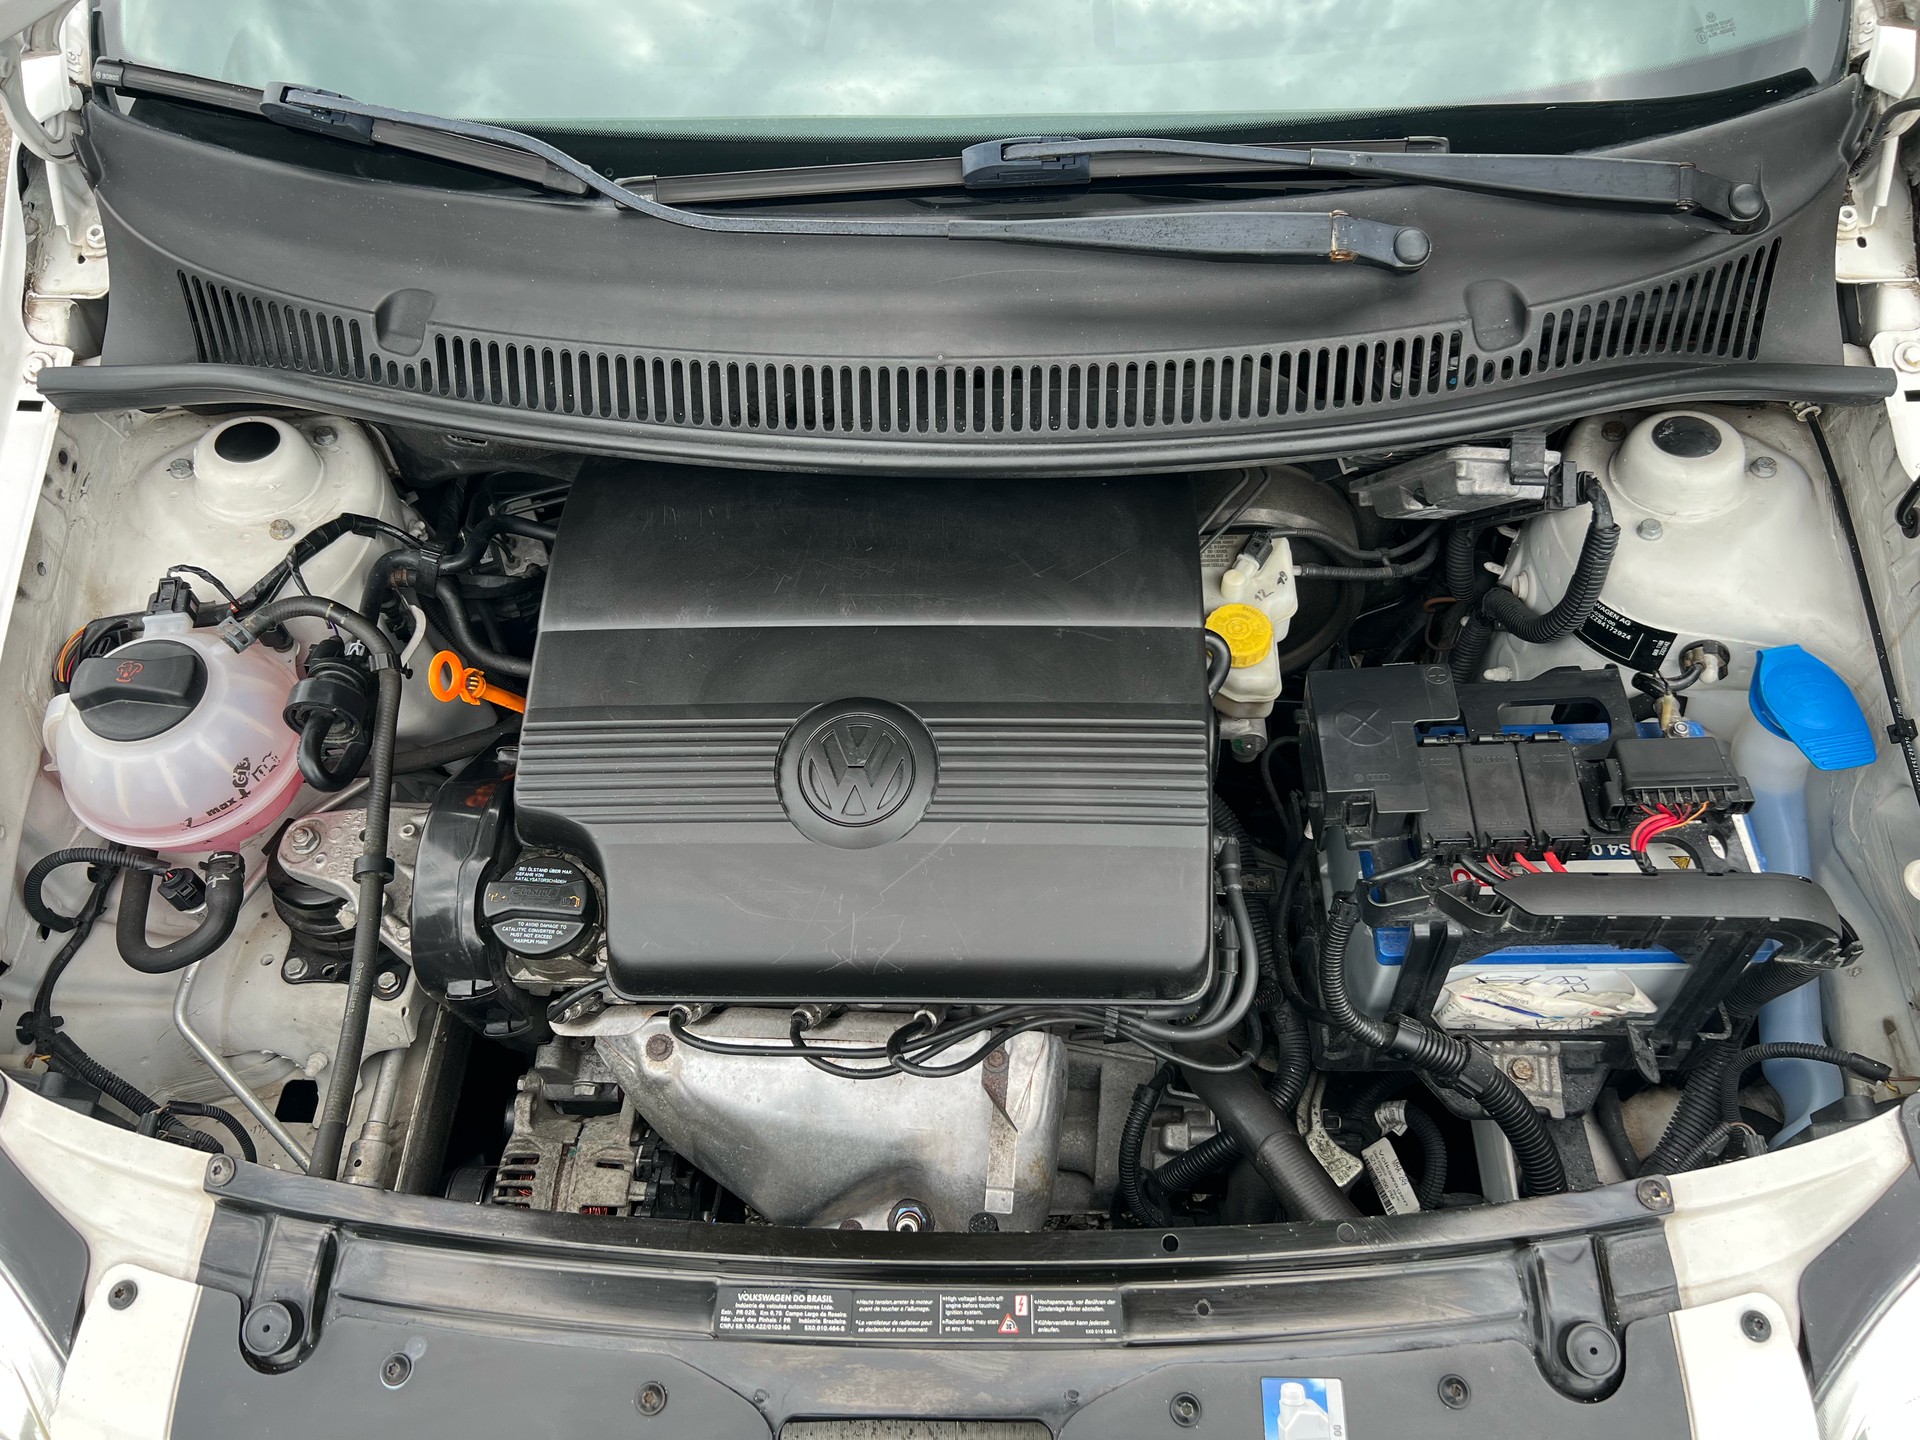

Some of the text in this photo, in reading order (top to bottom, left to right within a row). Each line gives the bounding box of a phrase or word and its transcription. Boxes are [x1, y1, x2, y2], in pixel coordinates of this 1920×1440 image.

[1620, 616, 1632, 627] AG
[206, 798, 238, 817] max
[1378, 1149, 1408, 1206] Volkswagen
[738, 1294, 791, 1302] VOLKSWAGEN
[807, 1294, 833, 1303] BRASIL
